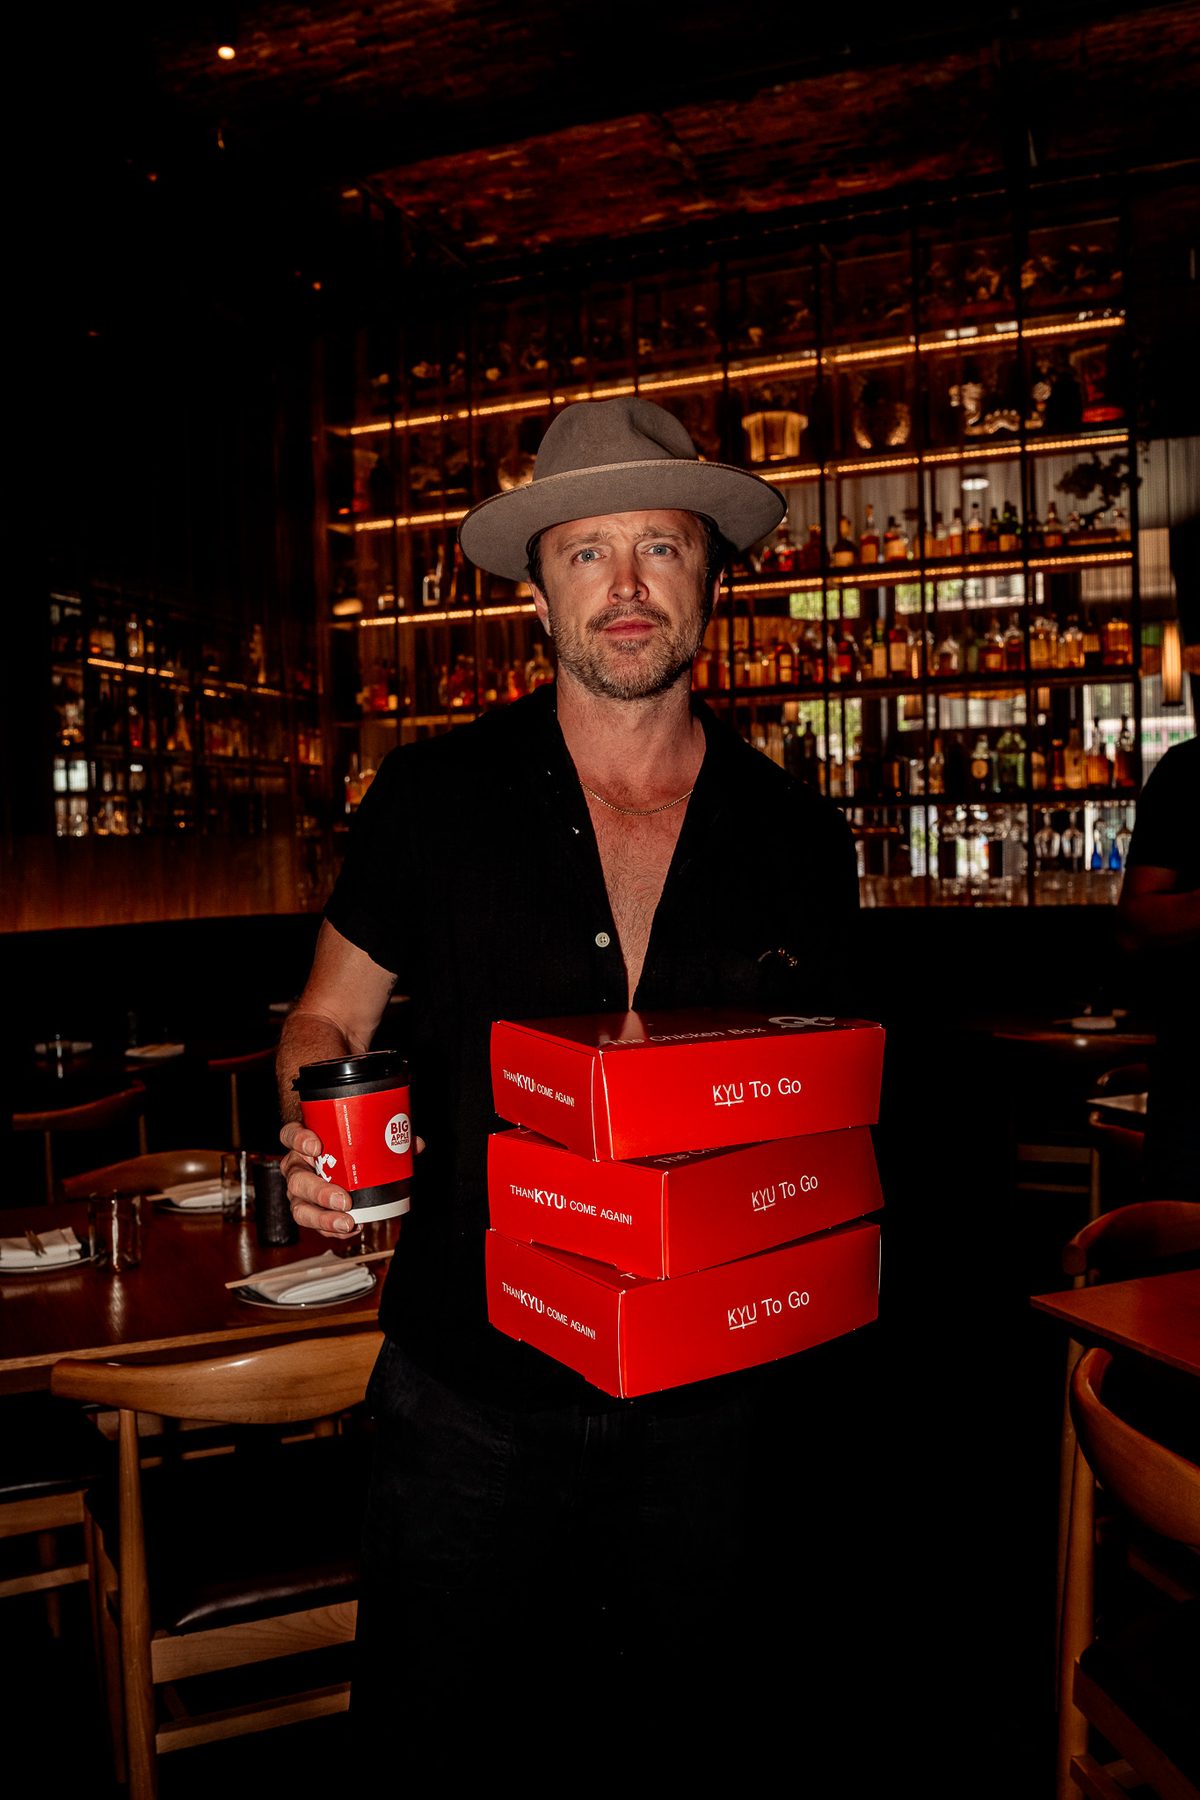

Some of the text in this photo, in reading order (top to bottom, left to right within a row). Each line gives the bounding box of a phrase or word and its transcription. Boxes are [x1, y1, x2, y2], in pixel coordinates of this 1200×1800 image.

[649, 1031, 725, 1041] Chicken
[728, 1027, 767, 1035] Box
[536, 1083, 554, 1099] COME
[555, 1091, 575, 1107] AGAIN!
[712, 1077, 802, 1107] KYU To Go
[390, 1120, 409, 1134] BIG
[391, 1132, 409, 1142] APPLE
[509, 1184, 632, 1225] THANKYU! COME AGAIN!
[751, 1174, 819, 1212] KYU To Go
[502, 1281, 596, 1340] THANKYU! COME AGAIN!
[727, 1290, 810, 1331] KYU To Go
